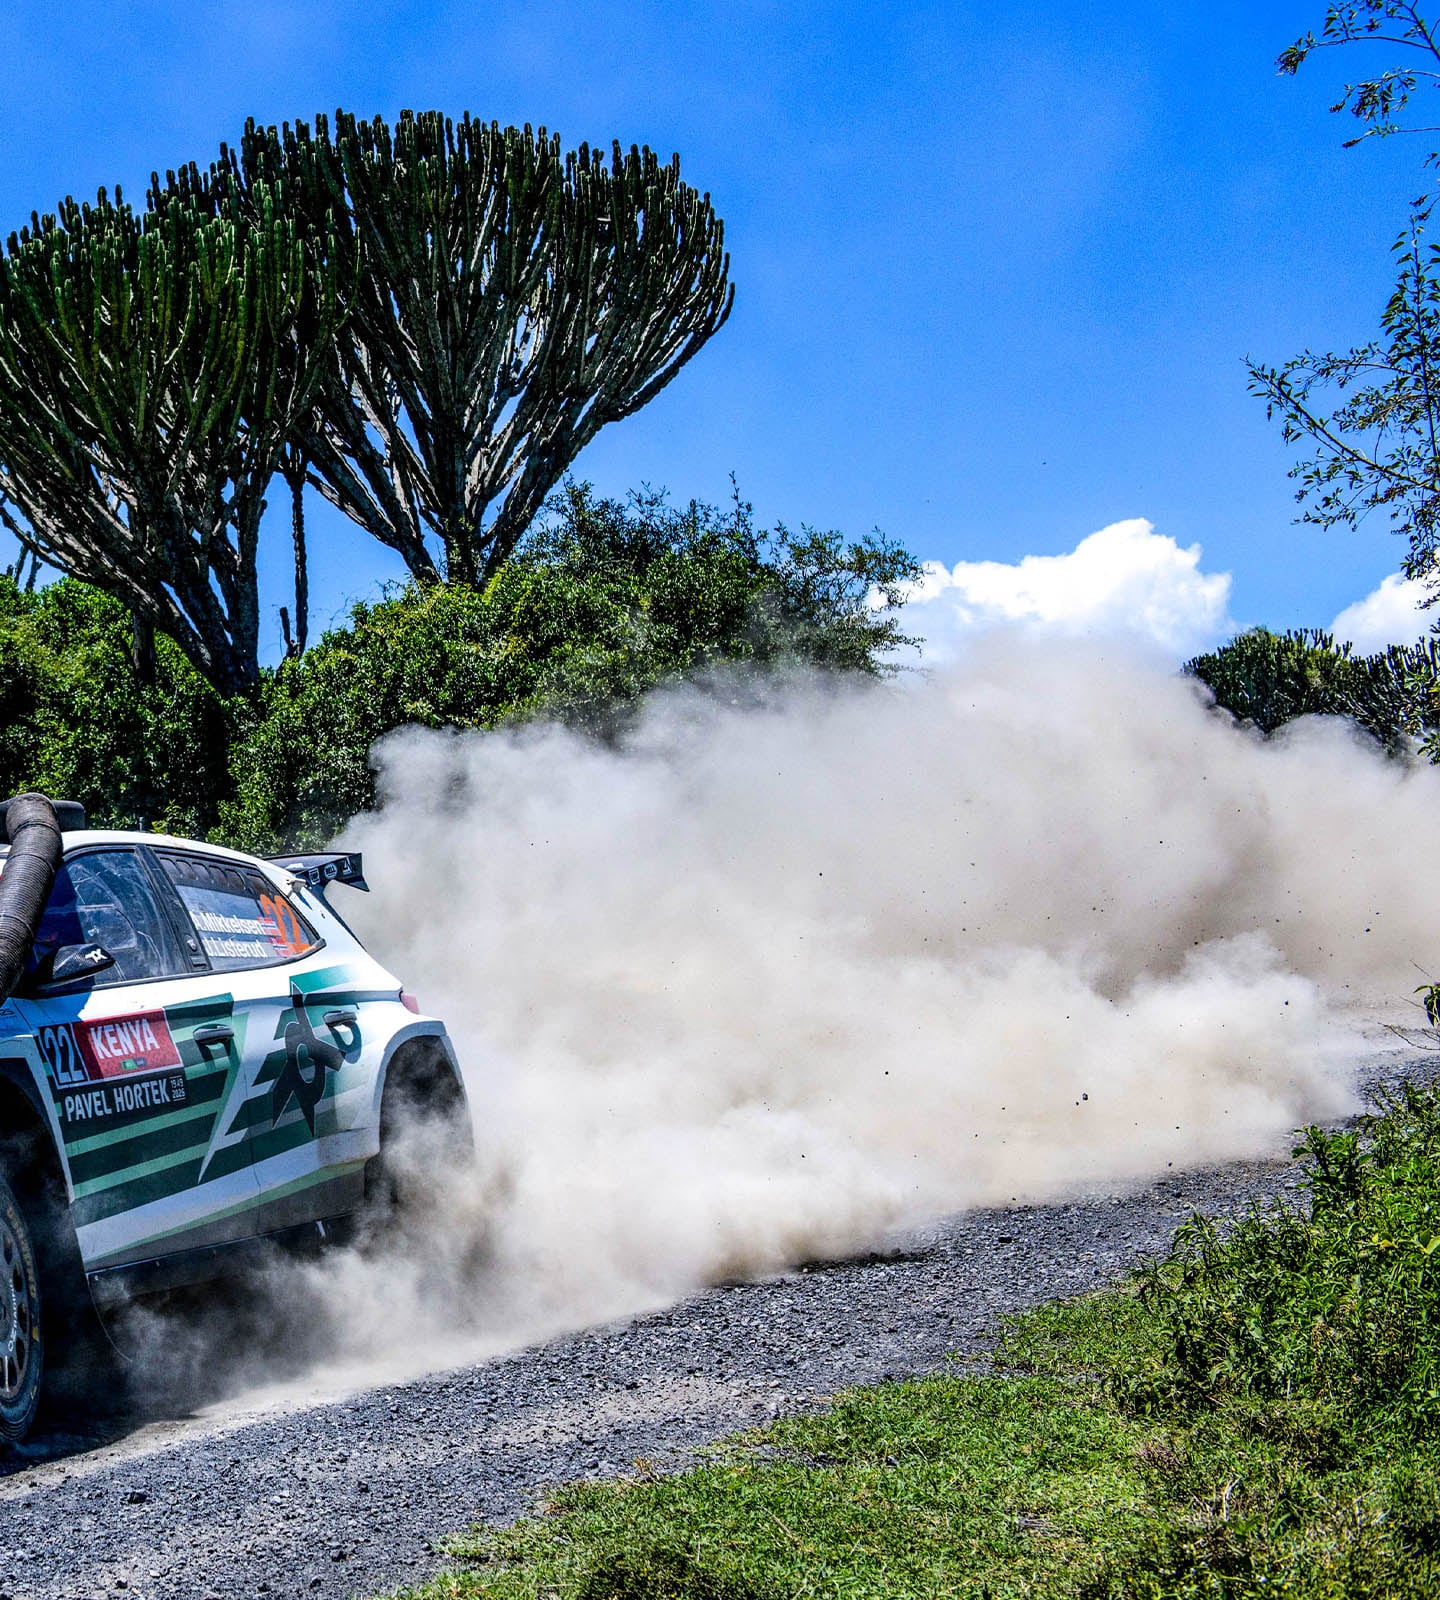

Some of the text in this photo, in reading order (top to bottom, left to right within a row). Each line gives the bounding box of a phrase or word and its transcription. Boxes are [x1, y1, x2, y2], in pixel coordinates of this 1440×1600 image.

[260, 894, 312, 955] 22
[44, 1026, 85, 1083] 22
[90, 1018, 160, 1059] KENYA
[65, 1078, 171, 1122] PAVEL HORTEK
